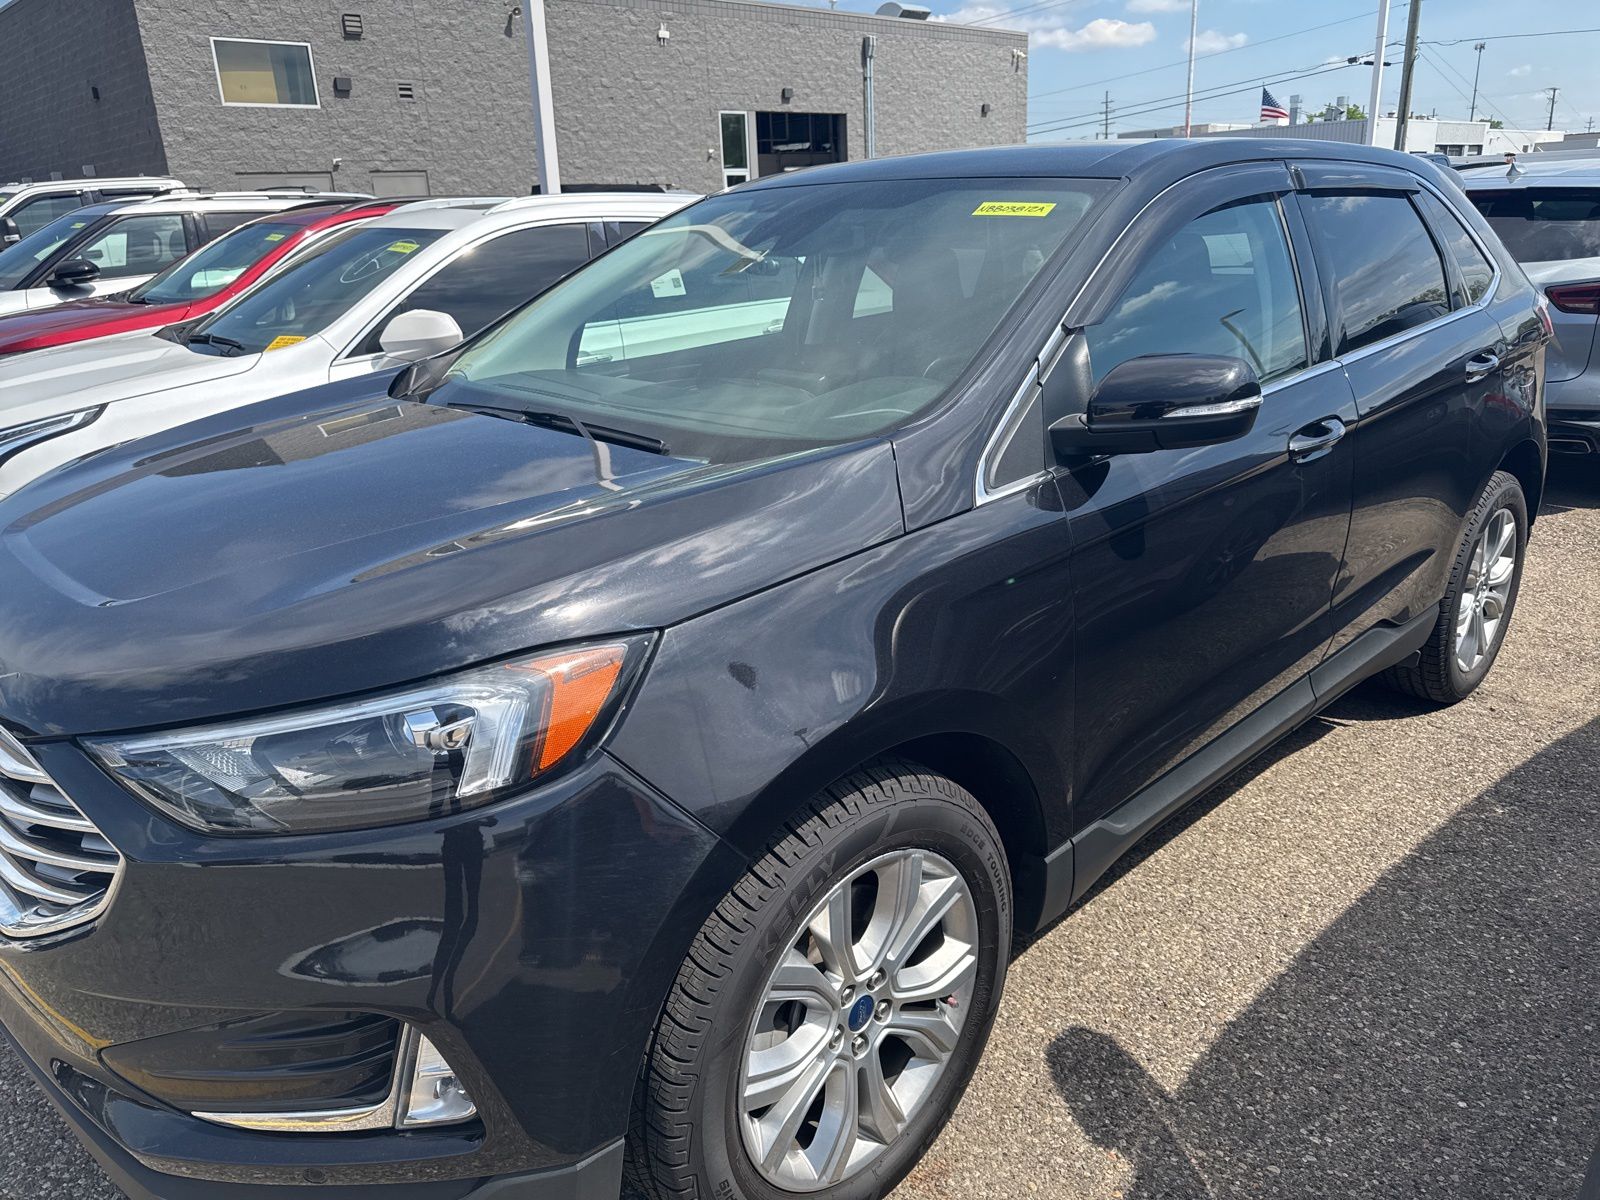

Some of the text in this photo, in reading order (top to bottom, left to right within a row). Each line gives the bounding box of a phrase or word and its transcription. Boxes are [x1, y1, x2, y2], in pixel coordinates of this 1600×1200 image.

[755, 850, 837, 965] KELLY
[960, 822, 1008, 913] EDGE TOURING
